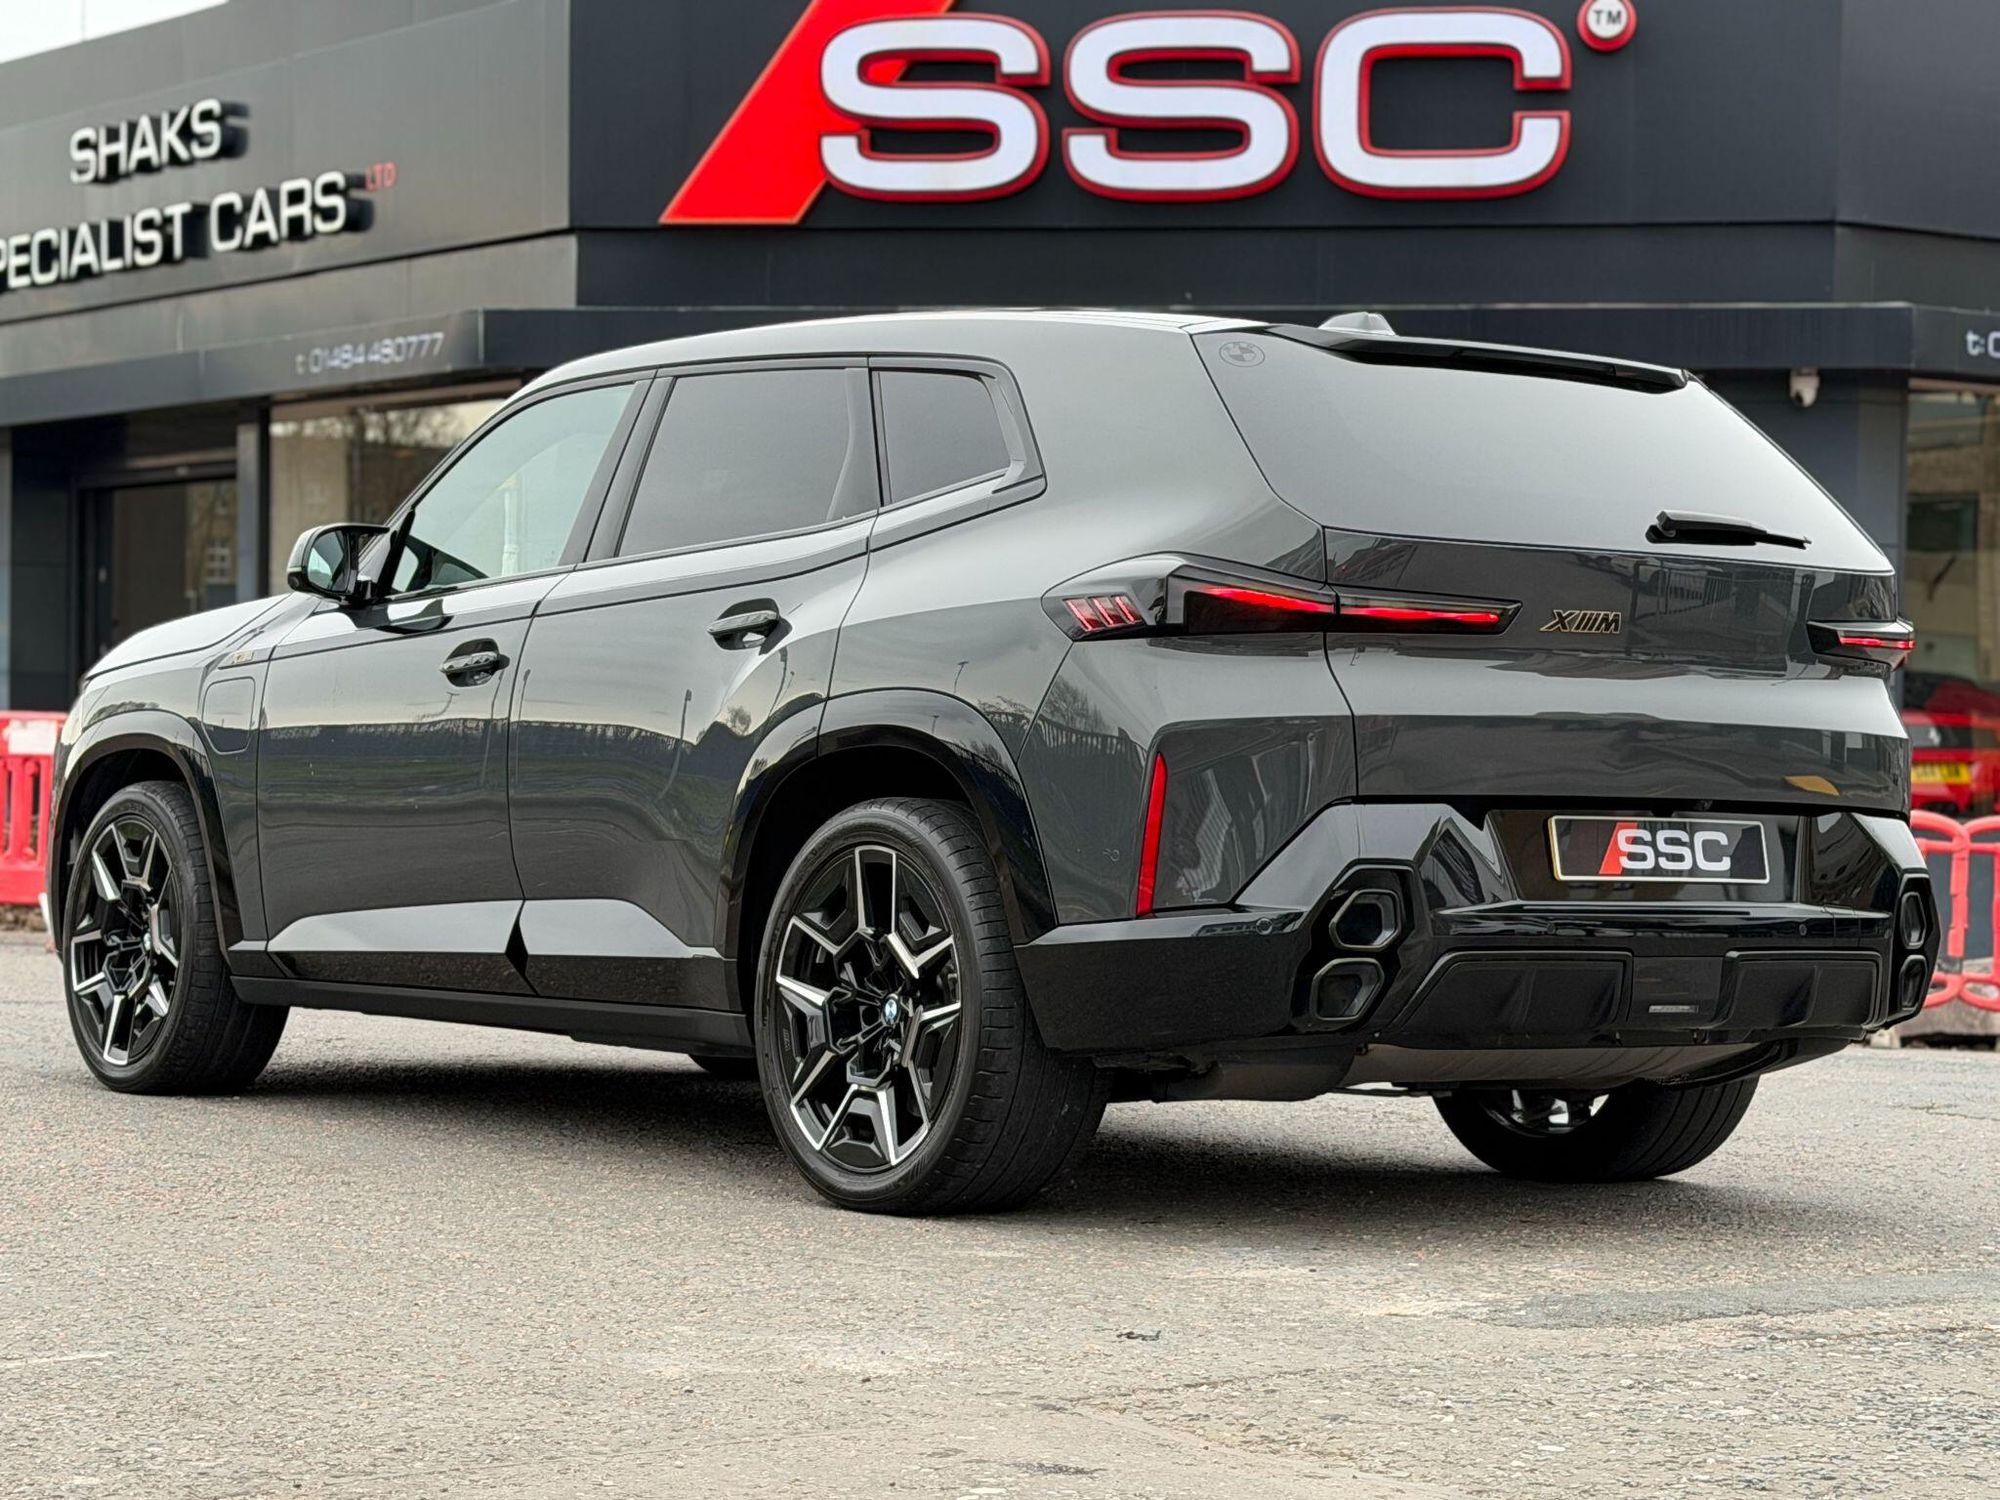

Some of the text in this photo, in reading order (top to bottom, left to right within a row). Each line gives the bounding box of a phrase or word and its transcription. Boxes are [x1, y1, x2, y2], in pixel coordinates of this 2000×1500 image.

[1593, 9, 1622, 25] TM
[70, 98, 222, 184] SHAKS
[820, 8, 1570, 199] SSC
[209, 170, 347, 251] CARS
[366, 161, 397, 192] LTD
[1617, 829, 1731, 871] SSC
